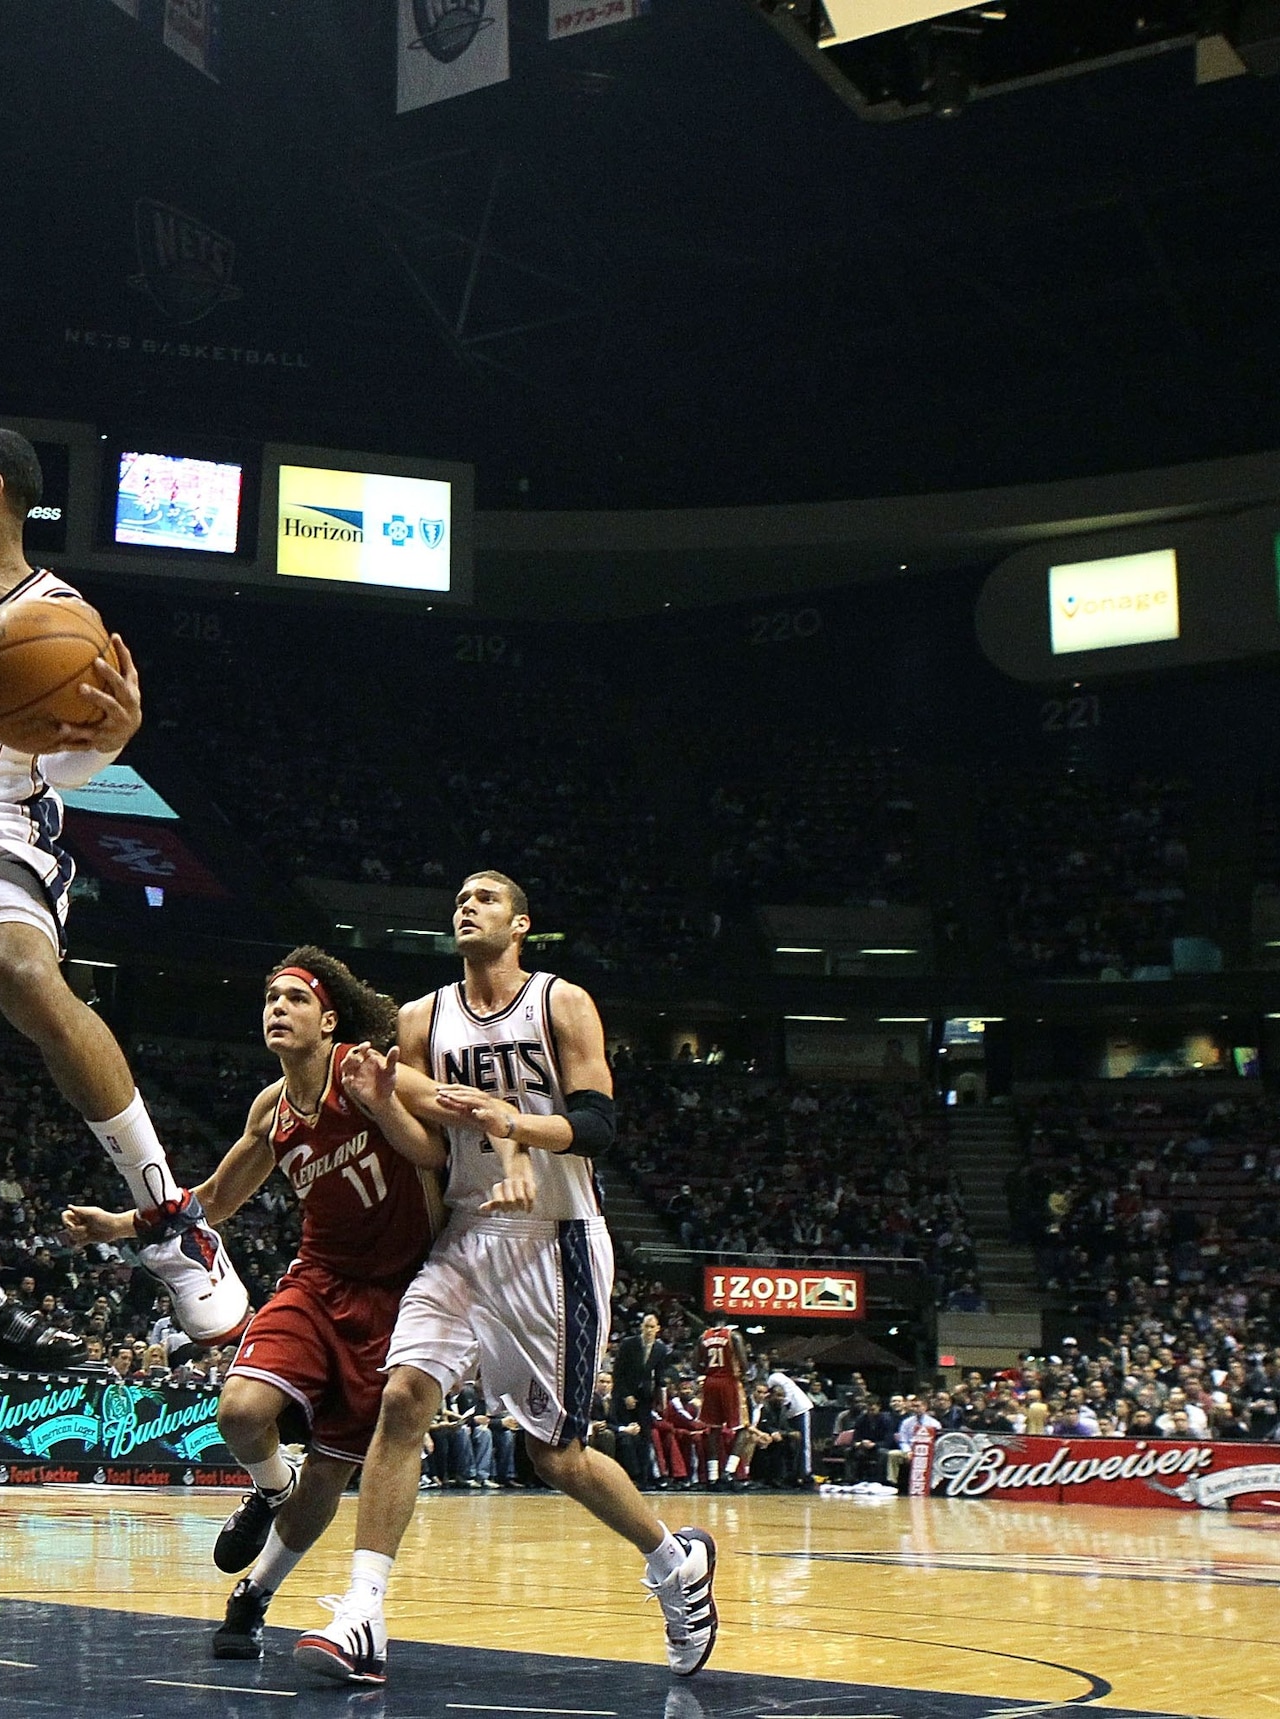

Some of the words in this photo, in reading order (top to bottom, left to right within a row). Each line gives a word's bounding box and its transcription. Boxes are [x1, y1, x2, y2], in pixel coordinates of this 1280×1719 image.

[284, 516, 365, 544] Horizon
[442, 1040, 553, 1099] NETS
[341, 1152, 388, 1209] 17
[712, 1275, 799, 1300] IZOD
[712, 1299, 798, 1310] CENTER
[708, 1347, 724, 1367] 21
[104, 1393, 218, 1459] Budweise
[10, 1464, 37, 1484] Foot
[39, 1464, 80, 1484] Locker
[106, 1466, 132, 1485] Foot
[133, 1467, 171, 1486] Locker
[937, 1441, 1212, 1496] Budweiser
